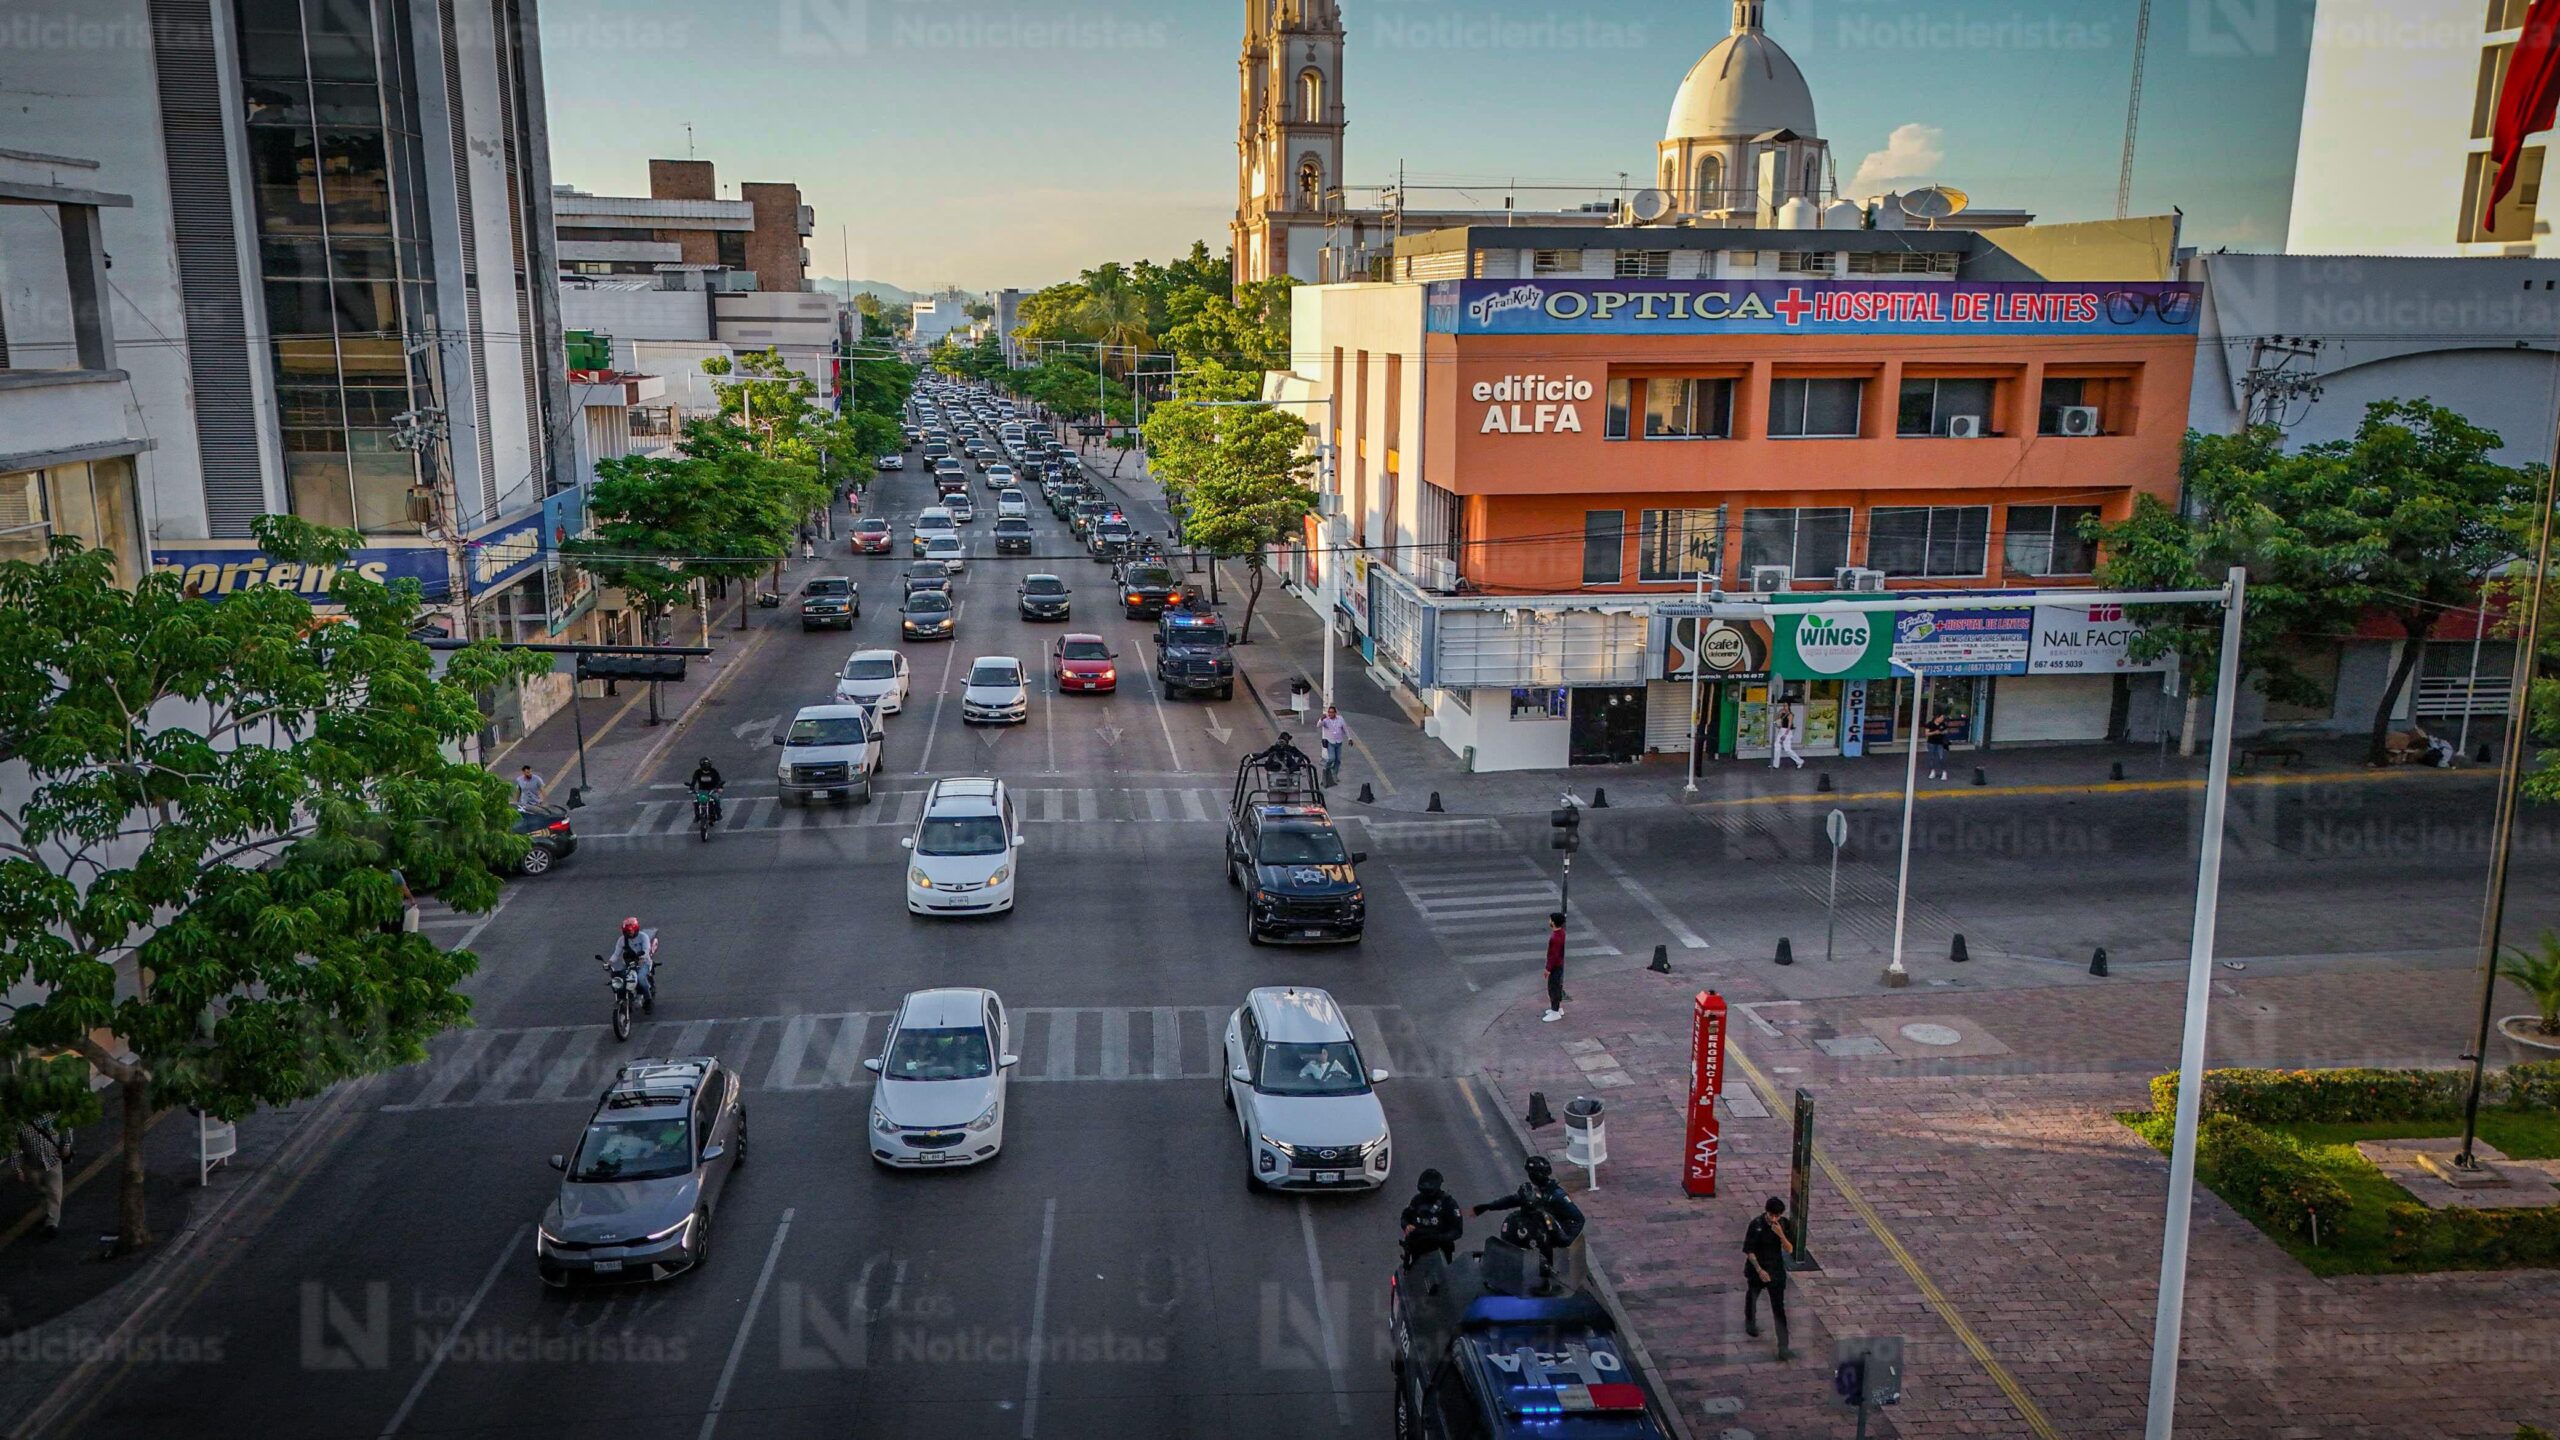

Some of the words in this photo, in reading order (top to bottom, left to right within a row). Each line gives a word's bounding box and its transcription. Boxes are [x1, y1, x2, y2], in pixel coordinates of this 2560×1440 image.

[1543, 291, 1775, 320] OPTICA
[1814, 291, 1947, 323] HOSPITAL
[1950, 293, 1989, 323] DE
[1993, 293, 2098, 323] LENTES
[1472, 374, 1594, 402] edificio
[1480, 404, 1583, 434] ALFA
[1800, 628, 1868, 646] WINGS
[2043, 630, 2082, 647] NAIL
[2086, 630, 2153, 647] FACTO
[1848, 690, 1863, 743] OPTICA
